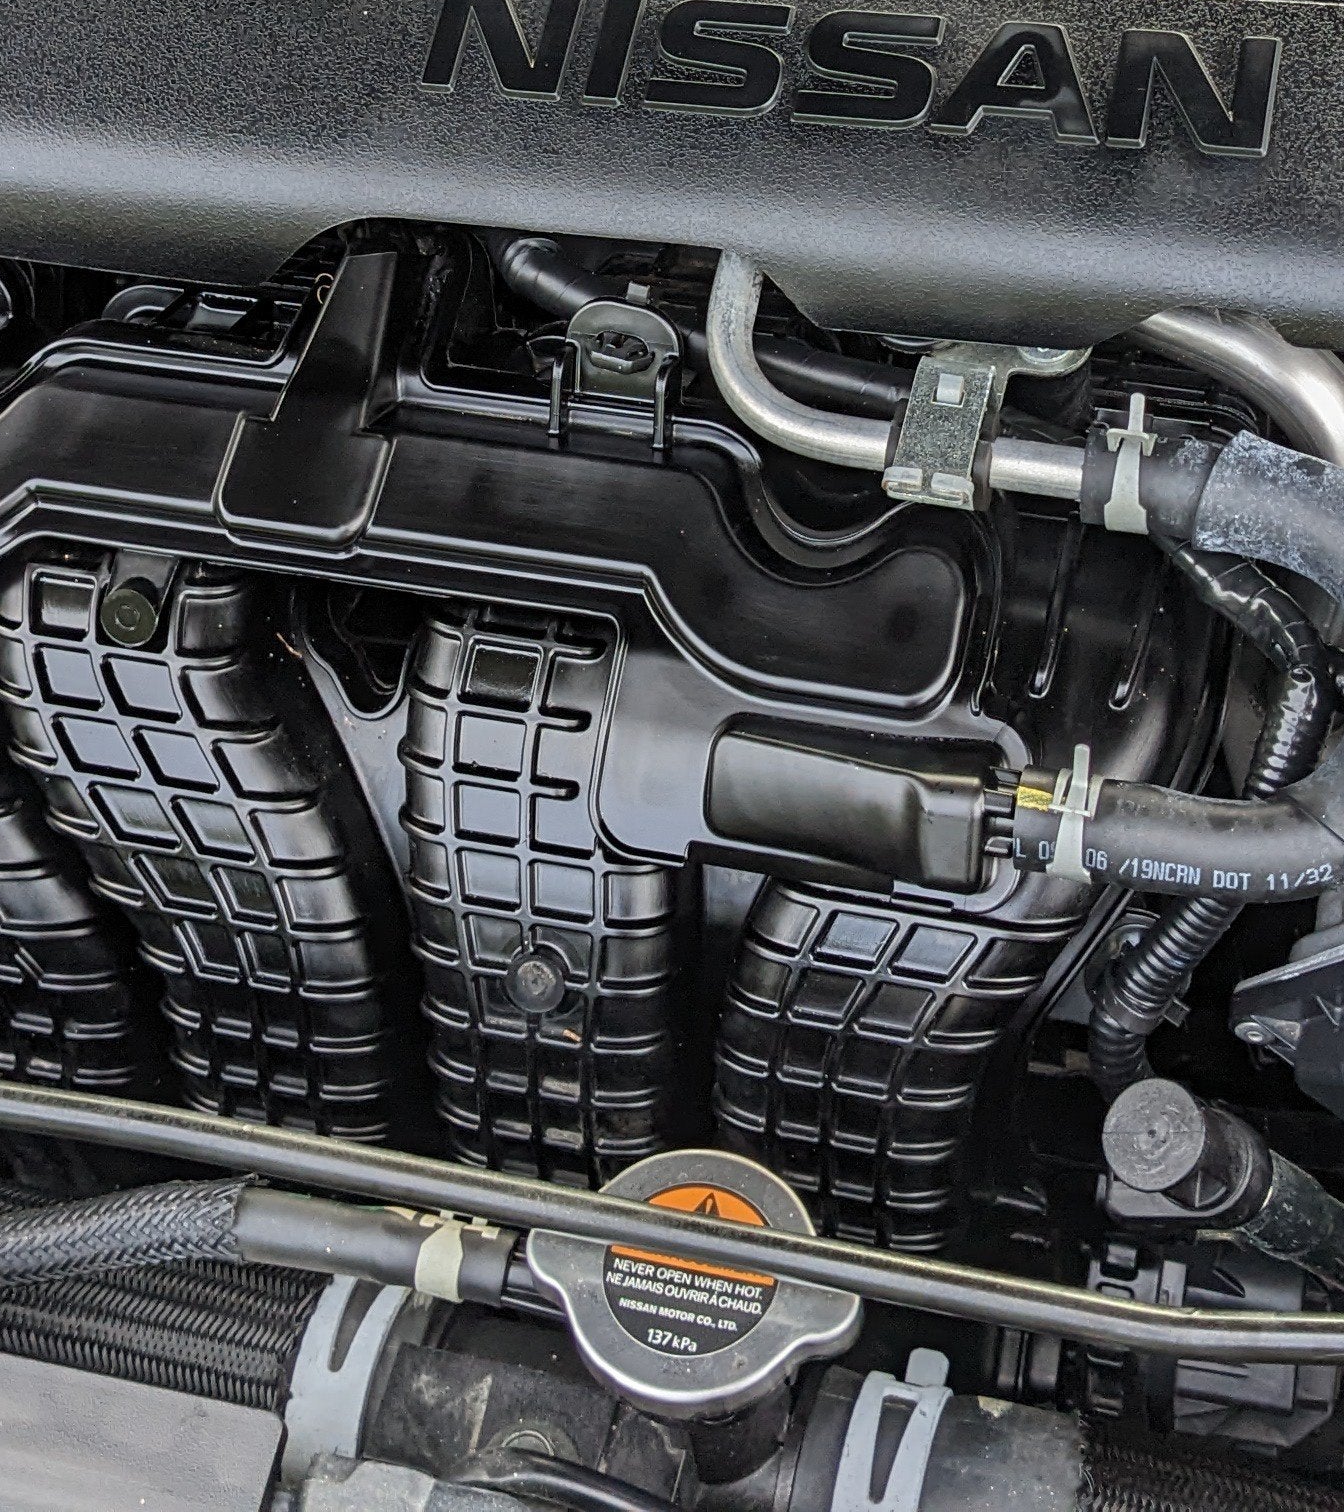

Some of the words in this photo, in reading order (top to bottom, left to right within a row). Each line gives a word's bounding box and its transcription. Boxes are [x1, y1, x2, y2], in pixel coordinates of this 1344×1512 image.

[1212, 869, 1252, 891] DOT
[1266, 863, 1335, 891] 11/32
[606, 1270, 621, 1286] NE
[622, 1275, 664, 1296] JAMAIS
[664, 1283, 708, 1305] OUVRIR
[718, 1295, 763, 1315] CHAUD.
[613, 1257, 655, 1278] NEVER
[656, 1267, 692, 1285] OPEN
[694, 1274, 734, 1295] WHEN
[733, 1284, 763, 1300] HOT.
[618, 1297, 658, 1315] NISSAN
[658, 1306, 696, 1324] MOTOR
[717, 1318, 738, 1332] LTD.
[646, 1328, 673, 1347] 137
[671, 1335, 698, 1353] kPa
